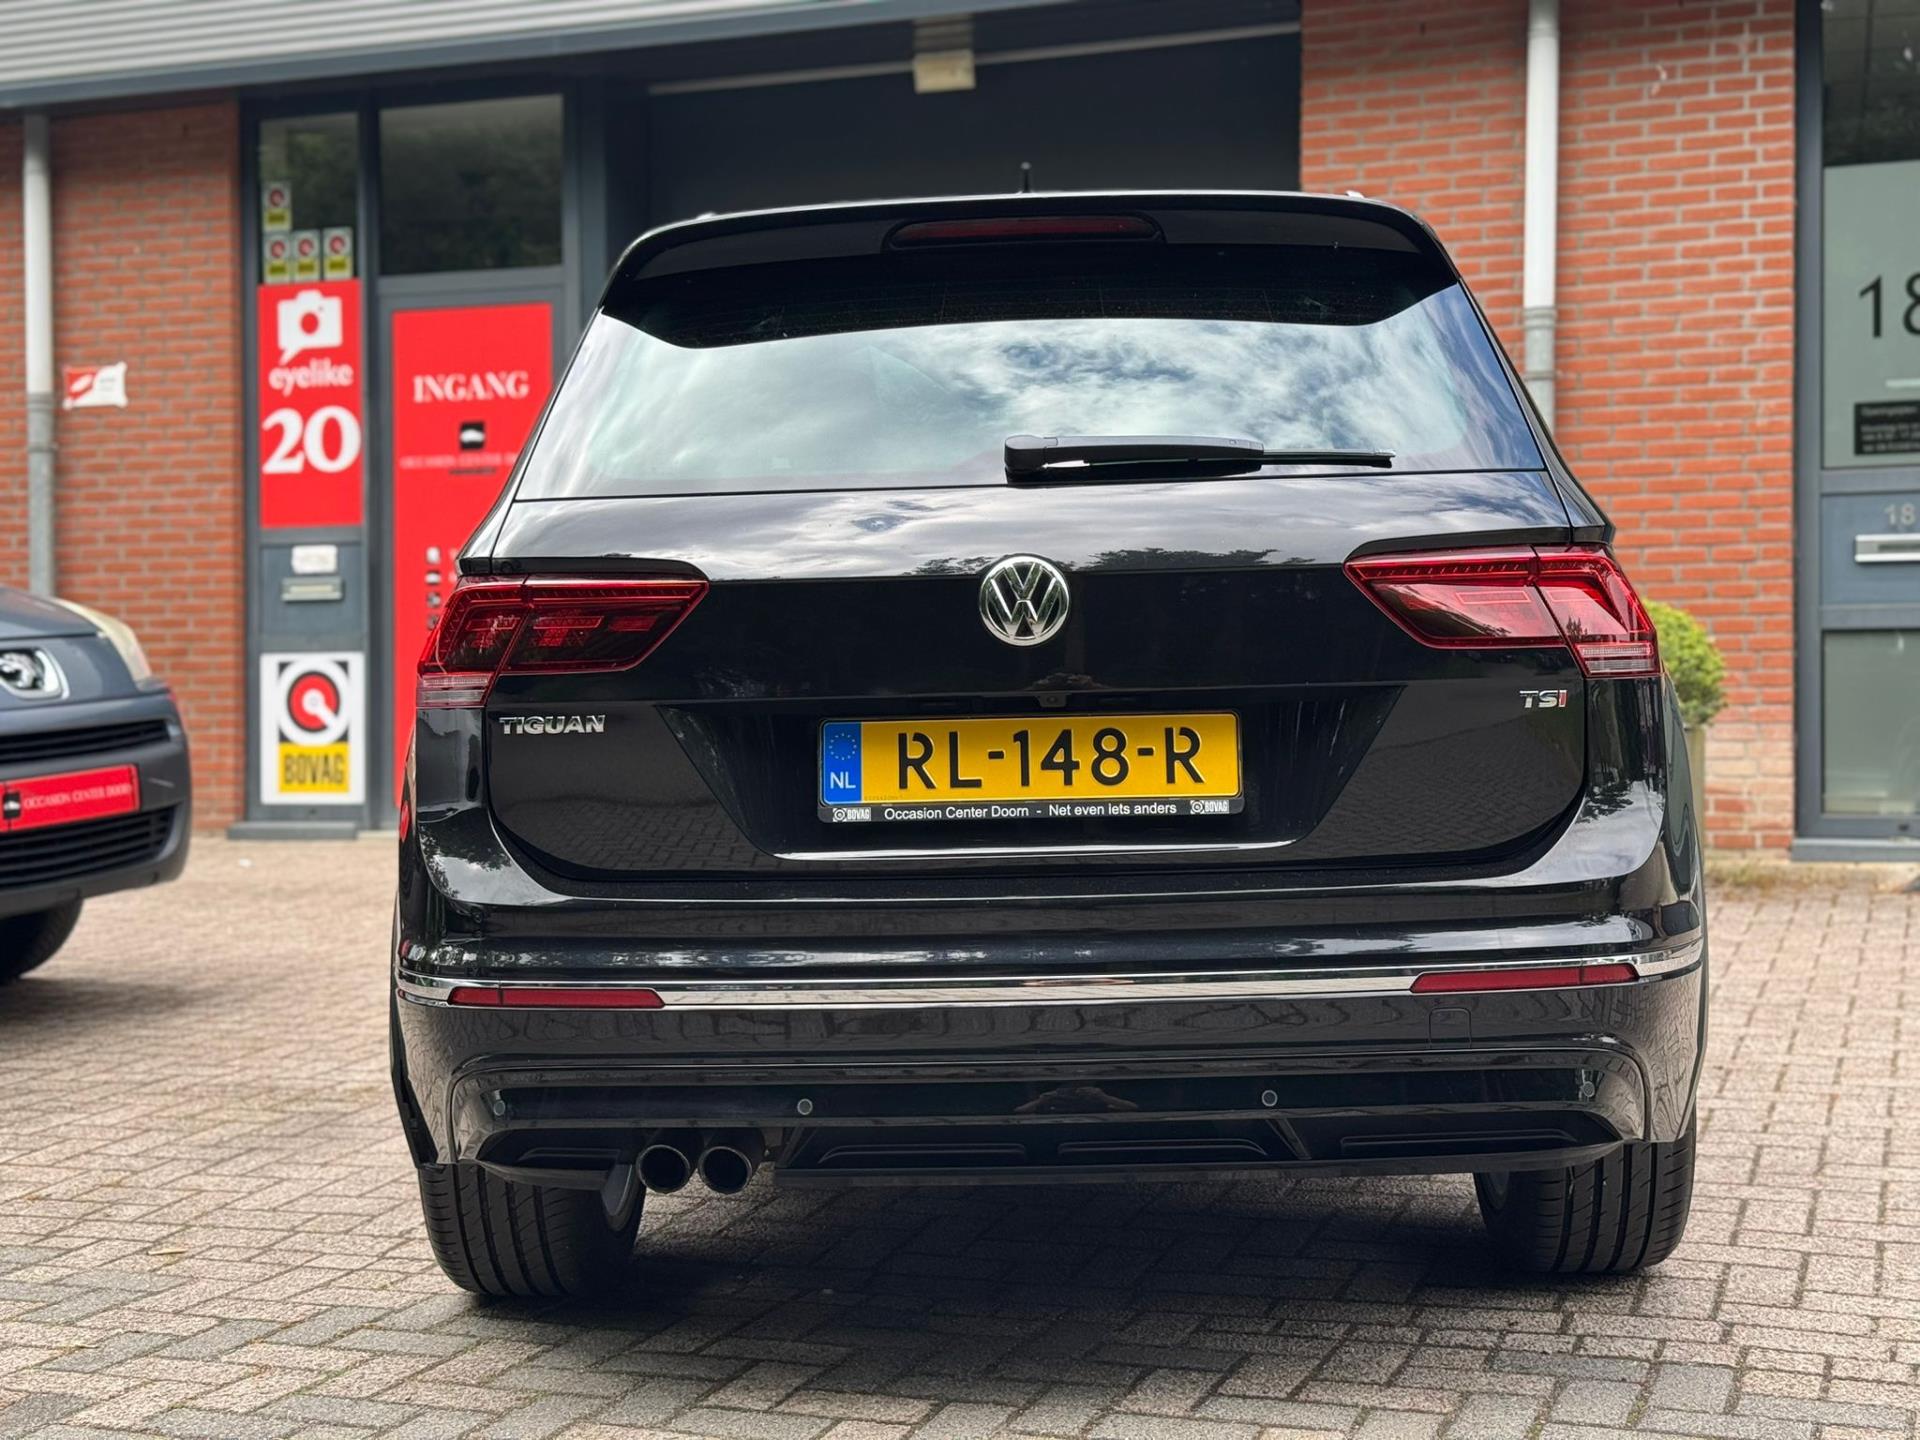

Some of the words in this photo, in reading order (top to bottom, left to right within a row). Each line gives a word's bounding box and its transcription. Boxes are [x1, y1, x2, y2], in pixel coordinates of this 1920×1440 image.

[268, 357, 355, 397] eyelike
[413, 369, 530, 404] INGANG
[262, 404, 361, 474] 20
[1884, 503, 1917, 526] 18
[1519, 689, 1568, 709] TSI
[498, 715, 606, 735] TIGUAN
[284, 752, 345, 785] BOVAG
[898, 726, 1206, 790] RL-148-R
[830, 771, 857, 789] NL
[884, 807, 942, 820] Occasion
[945, 806, 988, 819] Center
[1049, 804, 1071, 816] Net
[1074, 805, 1105, 816] even
[1133, 802, 1177, 815] anders
